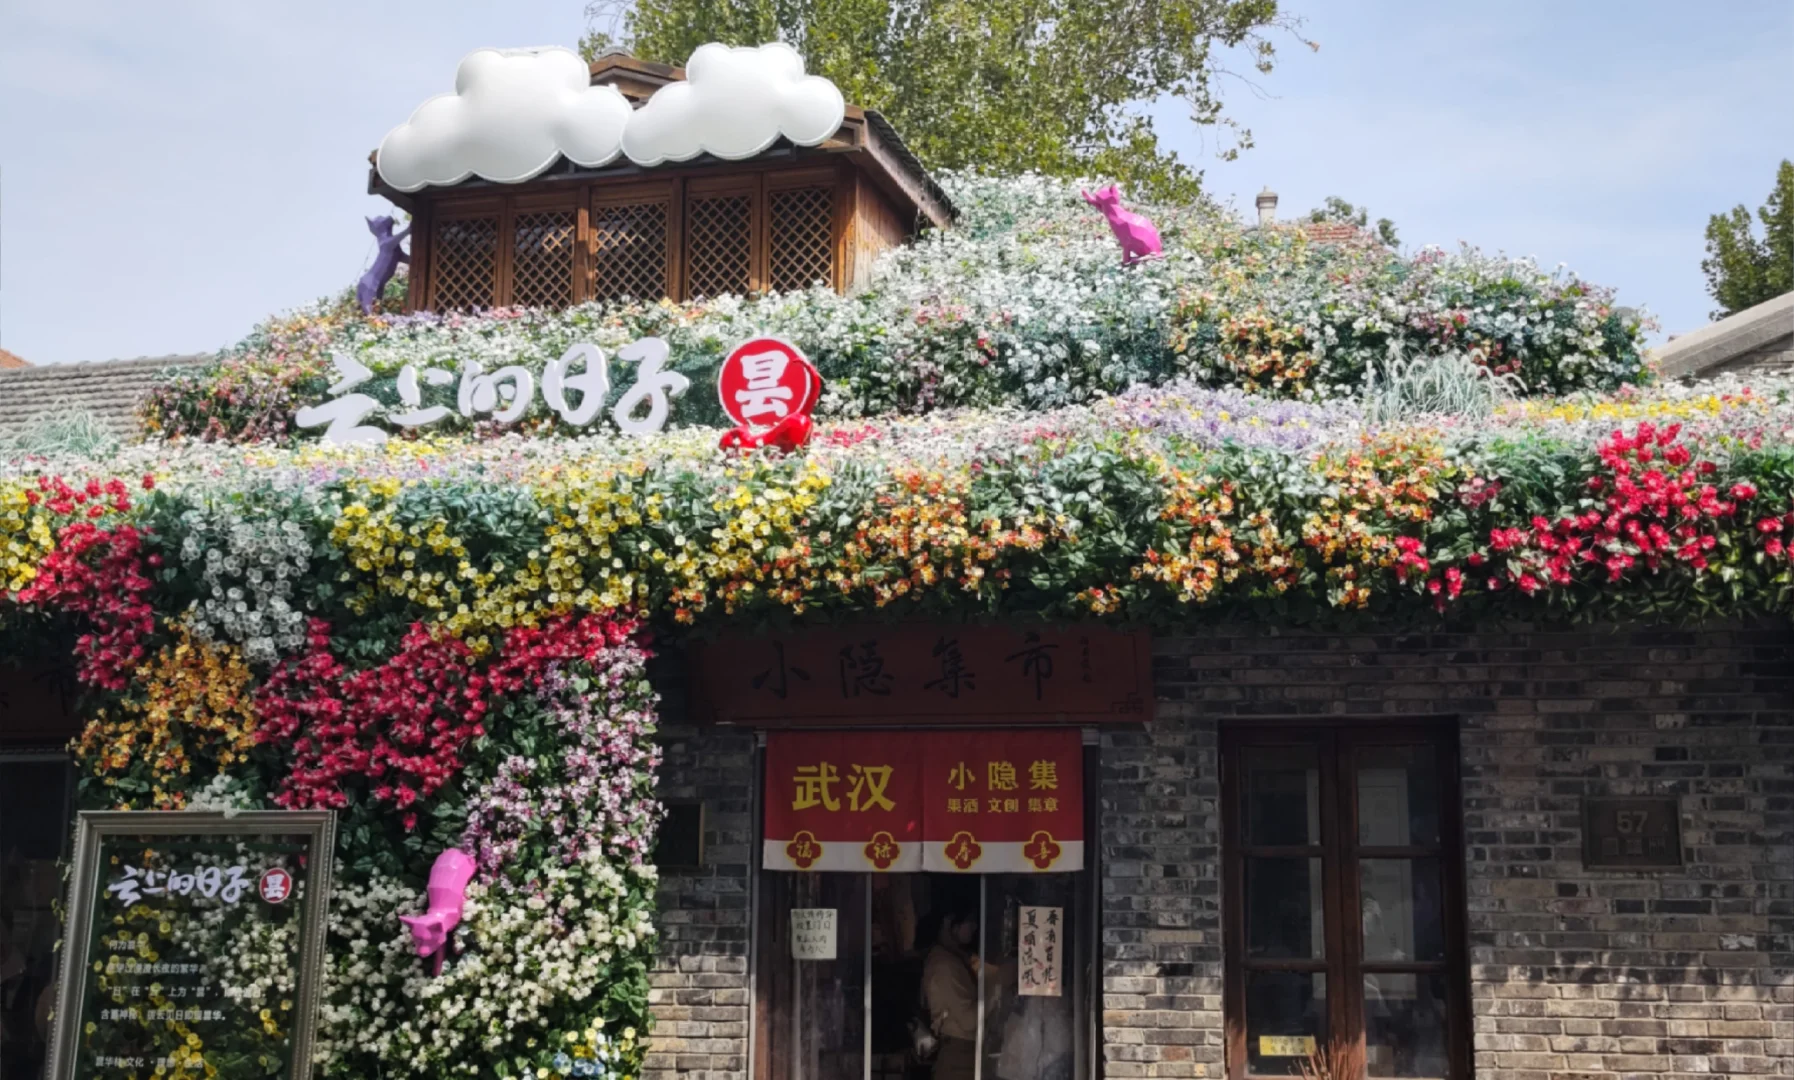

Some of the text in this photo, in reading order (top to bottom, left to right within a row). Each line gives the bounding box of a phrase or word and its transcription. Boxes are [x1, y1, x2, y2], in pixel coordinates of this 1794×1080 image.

[296, 337, 690, 444] 云上的日子
[752, 632, 1059, 700] 小隐集市
[792, 761, 896, 813] 武汉
[947, 759, 1059, 791] 小隐集
[947, 797, 1059, 813] 果酒 文创 集章
[1616, 810, 1649, 834] 57
[796, 841, 812, 859] 福
[872, 841, 891, 858] 禄
[1032, 841, 1051, 859] 喜
[108, 865, 250, 907] 云上的日子
